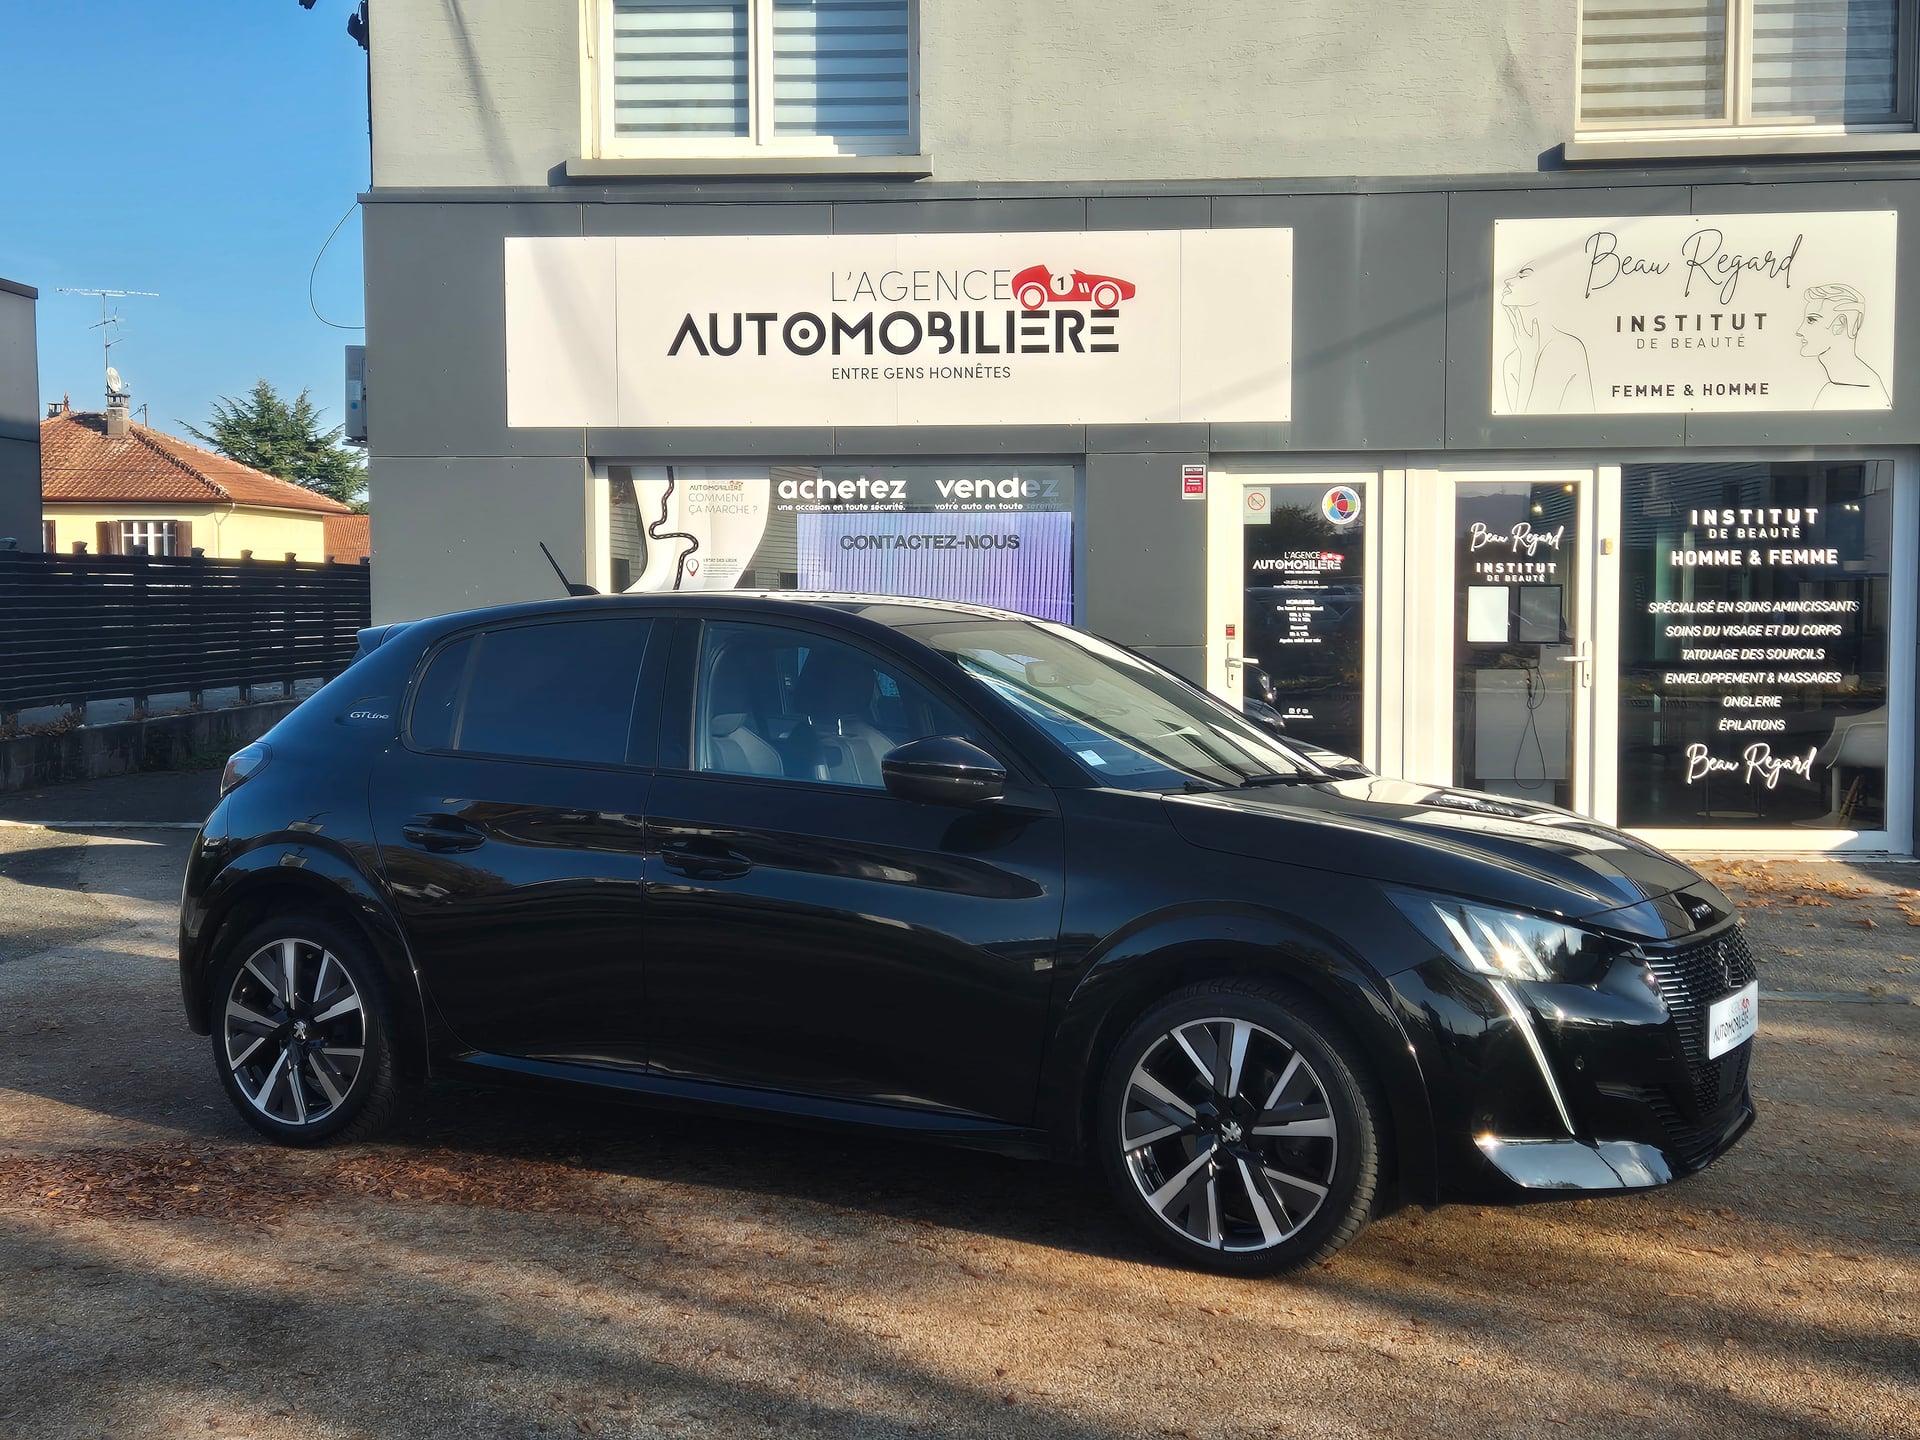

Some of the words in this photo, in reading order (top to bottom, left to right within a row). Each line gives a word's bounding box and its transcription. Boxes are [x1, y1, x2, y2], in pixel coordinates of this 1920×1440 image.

[1585, 231, 1670, 299] Beau
[1681, 228, 1803, 305] Regard
[831, 269, 1012, 302] L'AGENCE
[1616, 313, 1767, 332] INSTITUT
[1636, 338, 1658, 349] DE
[1671, 333, 1745, 348] BEAUTÉ
[832, 367, 879, 380] ENTRE
[884, 366, 924, 380] GENS
[929, 363, 1011, 379] HONNÊTES
[1612, 384, 1675, 397] FEMME
[1683, 384, 1695, 397] &
[1703, 383, 1769, 396] HOMME
[777, 471, 907, 500] achetez
[935, 471, 1060, 499] vendez
[688, 493, 745, 503] COMMENT
[688, 504, 703, 515] ÇA
[704, 504, 750, 515] MARCHE
[752, 505, 758, 513] ?
[796, 501, 831, 511] occasion
[846, 502, 868, 511] toute
[935, 502, 959, 510] votre
[961, 502, 982, 510] auto
[999, 502, 1023, 510] toute
[1691, 508, 1818, 525] INSTITUT
[1708, 528, 1728, 539] DE
[1737, 525, 1800, 538] BEAUTÉ
[839, 534, 1020, 550] CONTACTEZ-NOUS
[1470, 522, 1509, 552] Beau
[1511, 522, 1565, 557] Regard
[1671, 550, 1742, 566] HOMME
[1750, 549, 1762, 565] &
[1769, 549, 1838, 565] FEMME
[1476, 562, 1557, 573] INSTITUT
[1486, 574, 1500, 582] DE
[1504, 574, 1546, 582] BEAUTÉ
[1648, 600, 1715, 613] SPÉCIALISÉ
[1716, 601, 1734, 613] EN
[1735, 601, 1771, 613] SOINS
[1772, 601, 1860, 613] AMINCISSANTS
[1665, 625, 1701, 637] SOINS
[1702, 625, 1721, 637] DU
[1722, 625, 1764, 636] VISAGE
[1765, 625, 1781, 636] ET
[1782, 625, 1800, 636] DU
[1801, 624, 1842, 636] CORPS
[1682, 649, 1739, 660] TATOUAGE
[1740, 649, 1765, 660] DES
[1765, 649, 1826, 660] SOURCILS
[1665, 672, 1765, 684] ENVELOPPEMENT
[1767, 672, 1776, 683] &
[1777, 672, 1842, 683] MASSAGES
[1723, 695, 1782, 708] ONGLERIE
[1718, 717, 1786, 731] ÉPILATIONS
[1686, 743, 1739, 785] Beau
[1744, 743, 1818, 789] Regard
